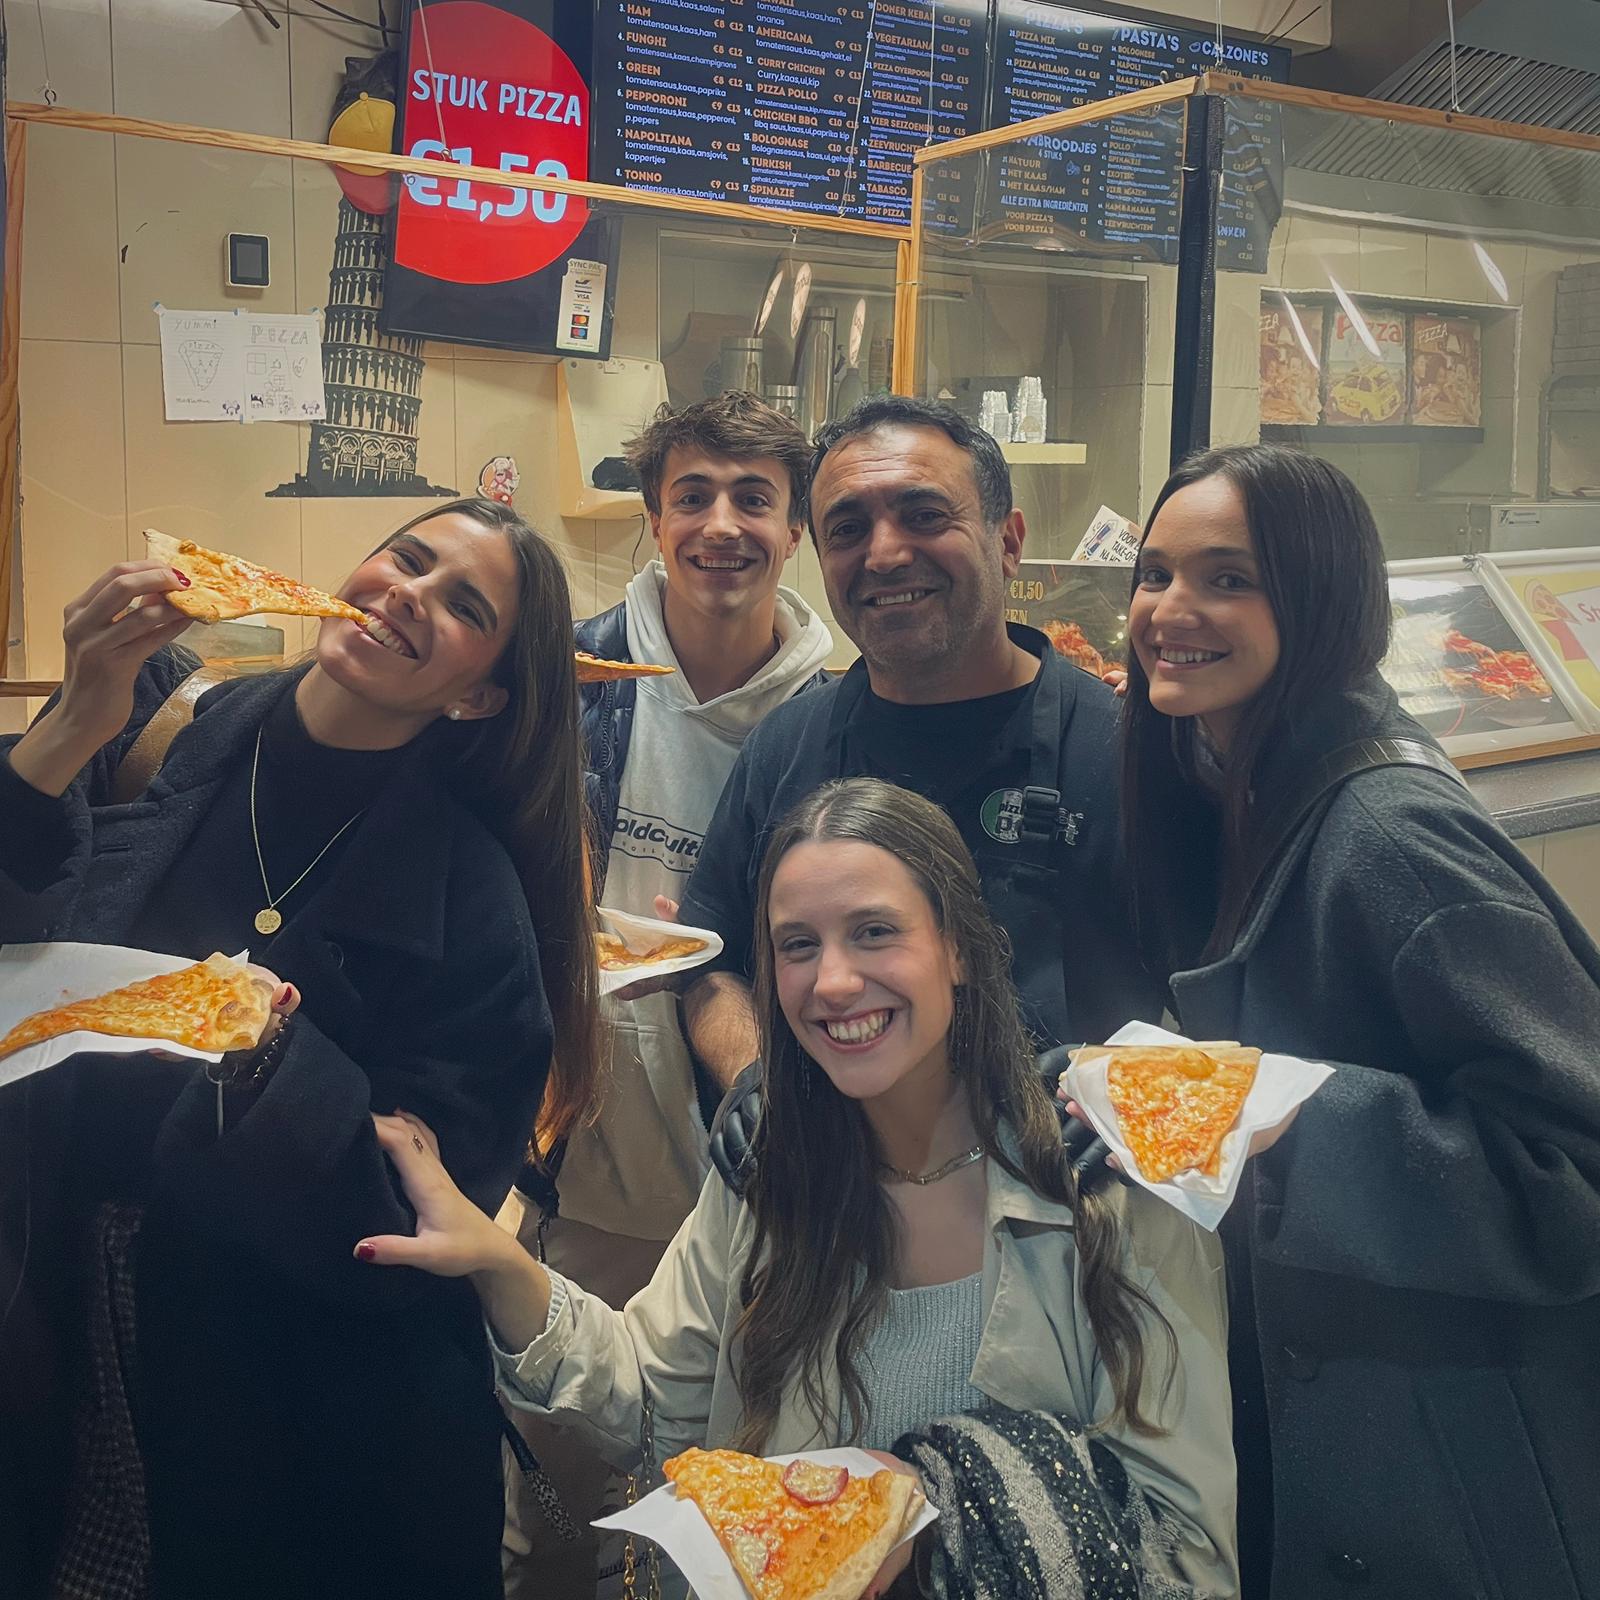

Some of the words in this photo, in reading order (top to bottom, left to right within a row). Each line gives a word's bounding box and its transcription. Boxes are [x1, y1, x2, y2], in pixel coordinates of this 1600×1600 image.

[627, 4, 651, 17] HAM
[729, 22, 744, 32] €12
[876, 2, 906, 17] DONER
[627, 16, 717, 38] tomatensaus,kaas,ham
[756, 14, 784, 26] ananas
[756, 26, 813, 44] AMERICANA
[1015, 30, 1039, 43] PIZZA
[1040, 35, 1056, 45] MIX
[1120, 28, 1180, 52] PASTA'S
[618, 33, 624, 41] 4.
[626, 32, 667, 47] FUNGHI
[728, 47, 743, 57] €12
[626, 45, 737, 69] tomatensaus,kaas,champignons
[757, 57, 786, 69] CURRY
[787, 62, 826, 75] CHICKEN
[873, 62, 894, 72] PIZZA
[1014, 59, 1037, 70] PIZZA
[1038, 62, 1069, 75] MILANO
[618, 62, 624, 70] 5.
[626, 62, 661, 76] GREEN
[728, 78, 743, 88] €12
[757, 70, 820, 88] Curry,kaas,ui,kip
[626, 75, 726, 97] tomatensaus,kaas,paprika
[757, 83, 786, 96] PIZZA
[788, 88, 818, 101] POLLO
[412, 69, 489, 112] STUK
[498, 83, 582, 127] PIZZA
[617, 89, 624, 98] 6.
[625, 89, 688, 107] PEPPORONI
[711, 101, 723, 110] €9
[727, 103, 741, 113] €13
[872, 90, 892, 101] VIER
[894, 92, 922, 105] KAZEN
[1012, 87, 1030, 99] FULL
[1031, 90, 1061, 103] OPTION
[625, 115, 659, 126] p.pepers
[753, 109, 796, 123] CHICKEN
[798, 116, 818, 126] BBQ
[871, 116, 889, 127] VIER
[754, 120, 768, 131] Bbq
[840, 131, 849, 141] kip
[625, 129, 692, 147] NAPOLITANA
[711, 140, 722, 150] €9
[726, 142, 741, 152] €13
[752, 133, 809, 149] BOLOGNASE
[625, 152, 666, 164] kappertjes
[751, 157, 792, 170] TURKISH
[867, 160, 912, 172] BARBECUE
[403, 139, 569, 223] €1,50
[624, 169, 662, 182] TONNO
[710, 180, 722, 189] €9
[725, 181, 739, 191] €13
[750, 185, 795, 198] SPINAZIE
[866, 183, 907, 195] TABASCO
[1000, 195, 1016, 206] ALLE
[1018, 197, 1041, 208] EXTRA
[866, 207, 881, 215] HOT
[882, 209, 905, 218] PIZZA
[1006, 211, 1024, 220] VOOR
[1119, 529, 1137, 546] VOOR
[1009, 580, 1044, 601] €1,50
